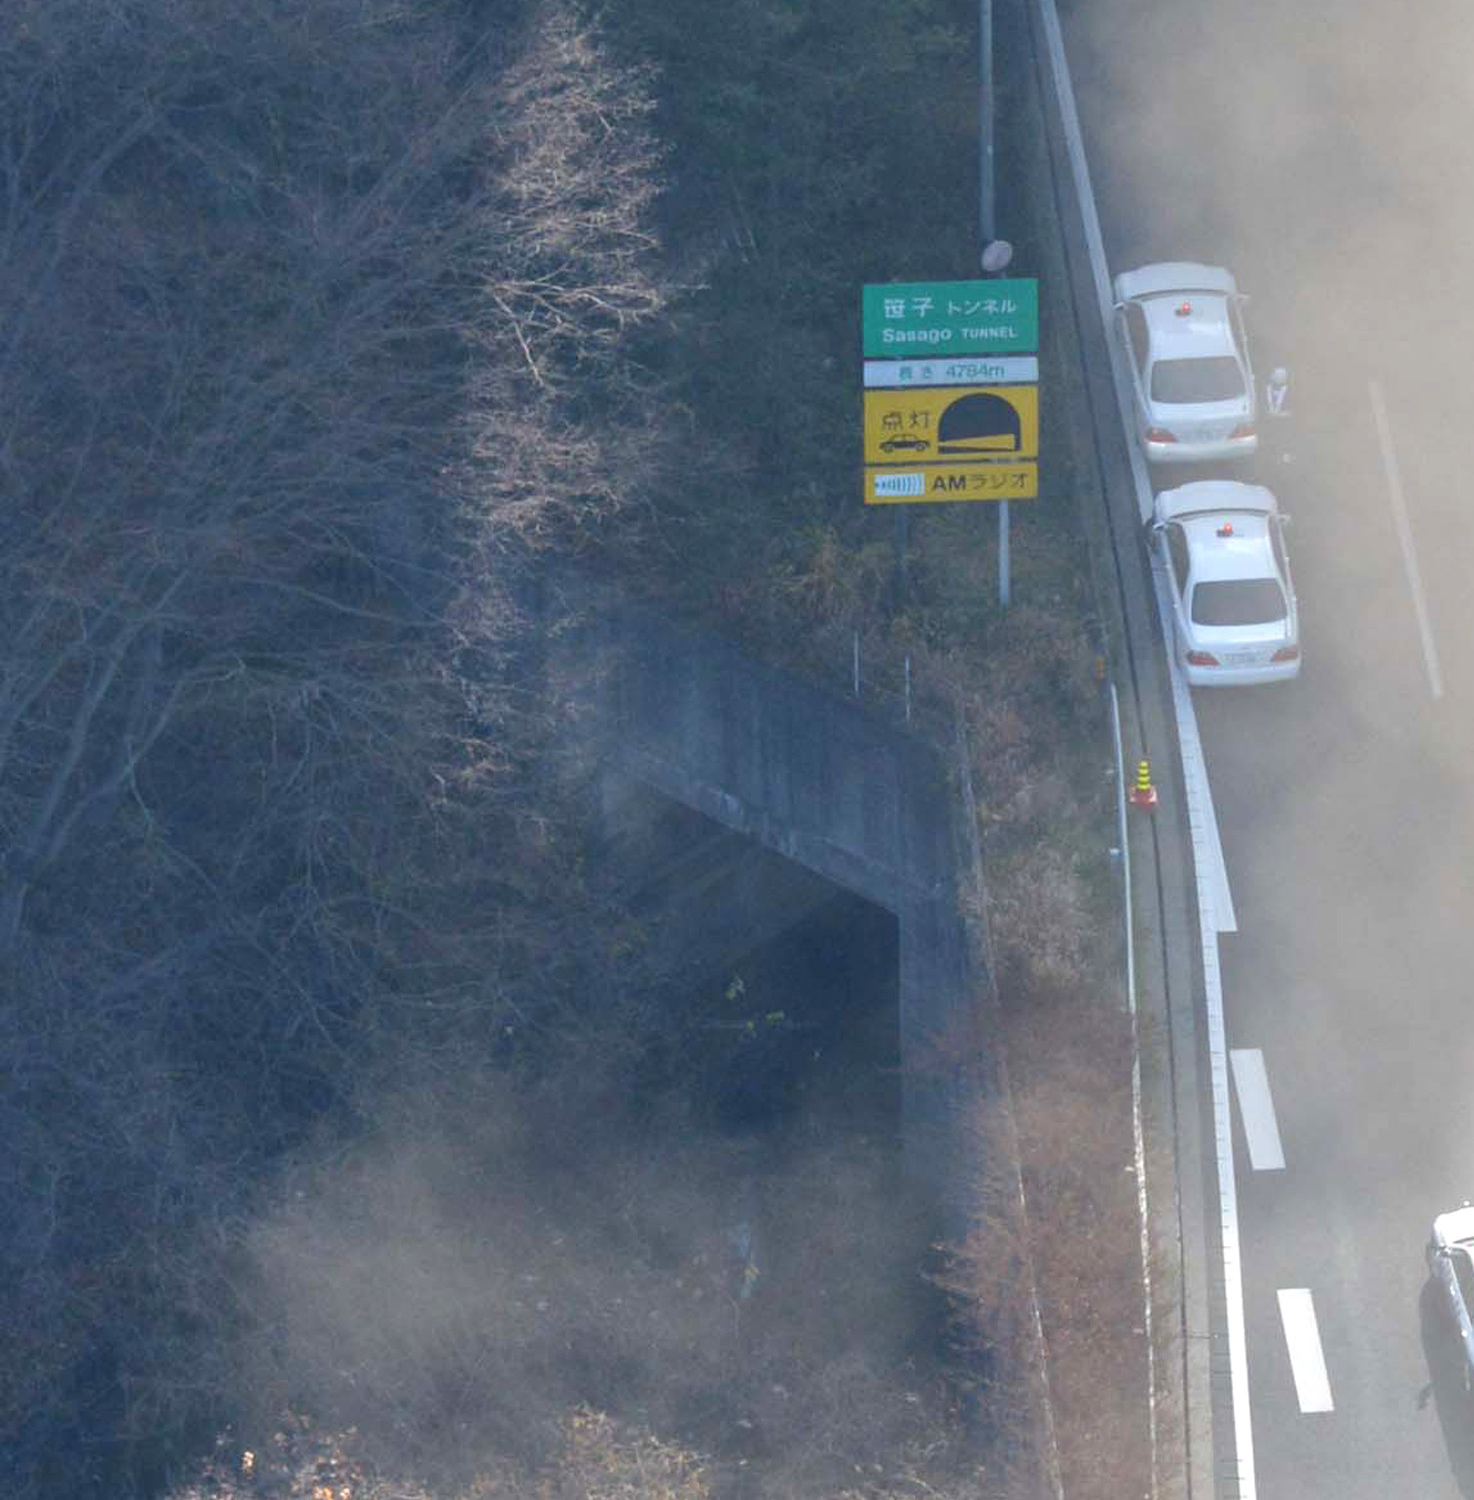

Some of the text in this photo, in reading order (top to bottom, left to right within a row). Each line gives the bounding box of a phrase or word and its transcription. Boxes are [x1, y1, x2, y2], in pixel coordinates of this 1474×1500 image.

[948, 299, 1017, 317] トンネル
[882, 325, 1018, 344] Sasago TUNNEL
[881, 410, 930, 430] 点灯
